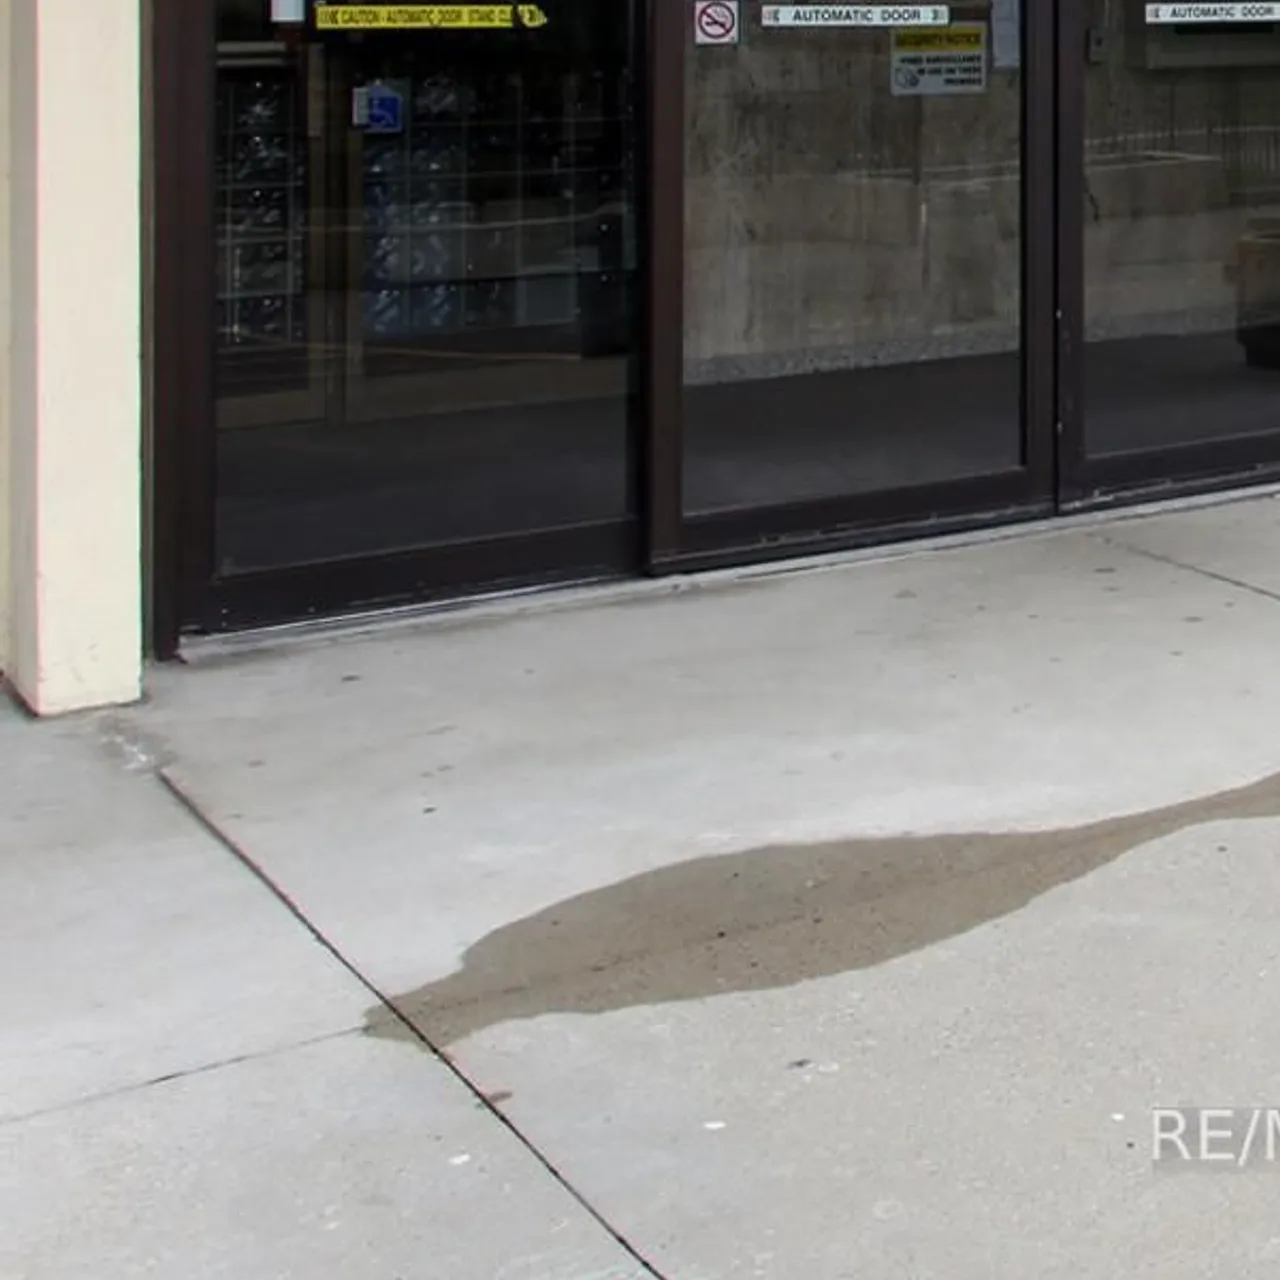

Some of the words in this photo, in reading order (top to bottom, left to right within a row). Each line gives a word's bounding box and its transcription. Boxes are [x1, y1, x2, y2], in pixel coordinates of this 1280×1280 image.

[793, 9, 874, 21] AUTOMATIC
[880, 9, 921, 20] DOOR
[1170, 7, 1236, 18] AUTOMATIC
[1242, 6, 1275, 17] DOOR
